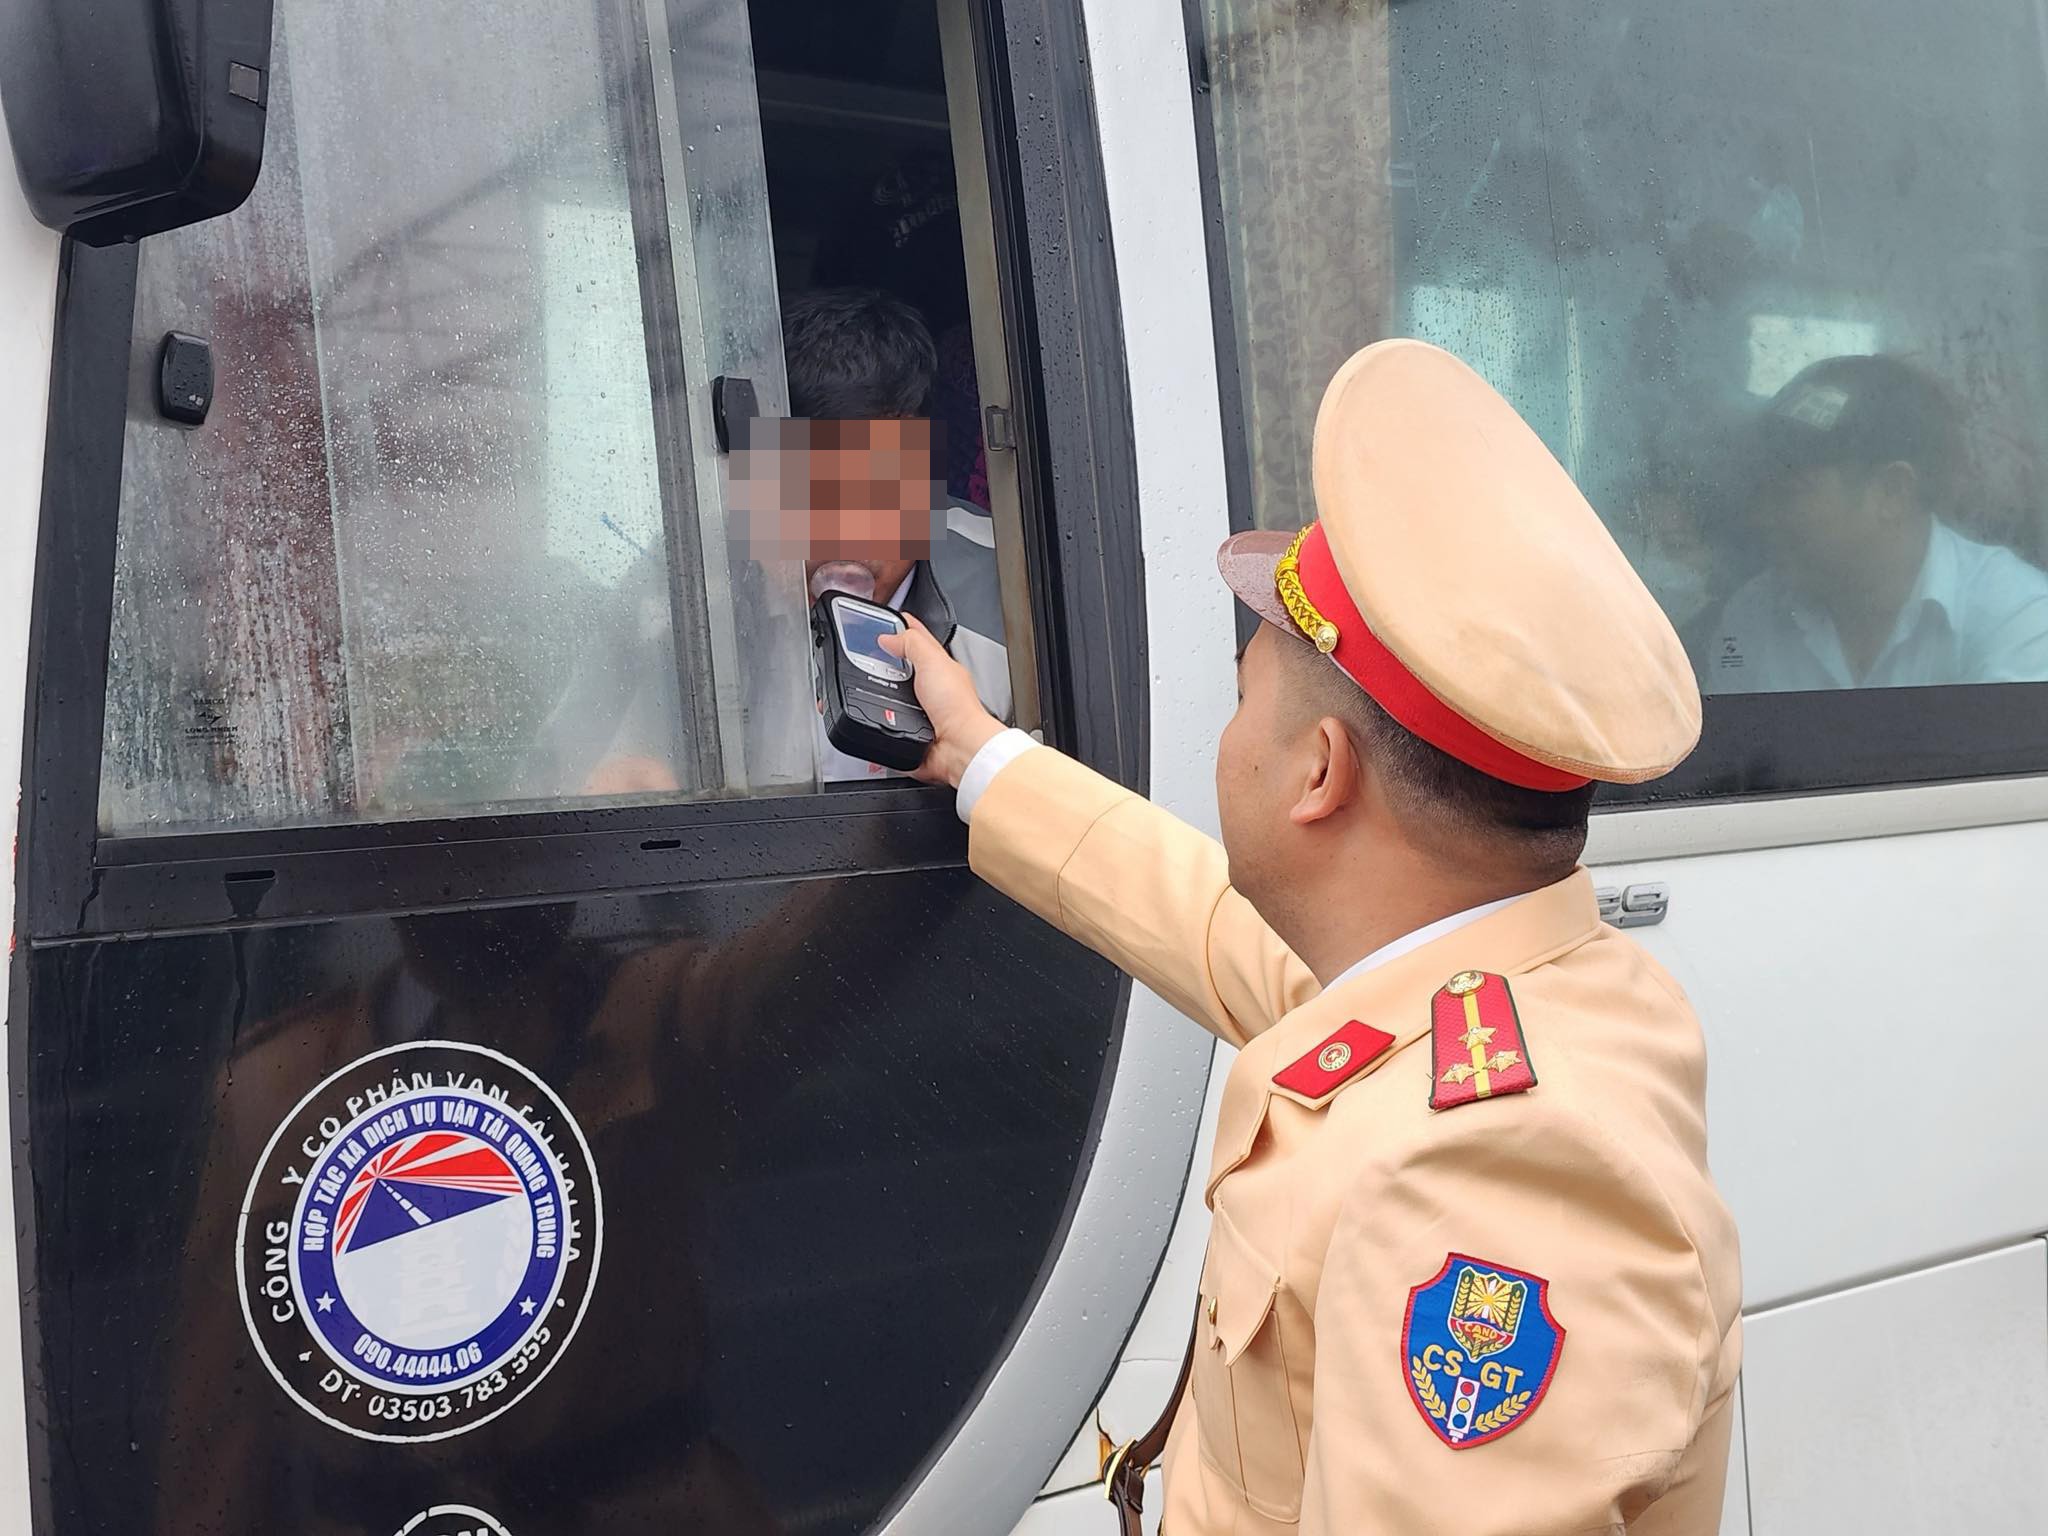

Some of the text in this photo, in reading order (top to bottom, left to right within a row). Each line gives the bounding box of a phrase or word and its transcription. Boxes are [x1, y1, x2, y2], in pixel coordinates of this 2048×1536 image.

[302, 1099, 556, 1259] HỢP TÁC XÃ DỊCH VỤ VẬN TẢI QUANG TRUNG
[1464, 1323, 1498, 1339] CAND
[353, 1333, 483, 1378] 090.44444.06
[1422, 1344, 1524, 1394] CS GT
